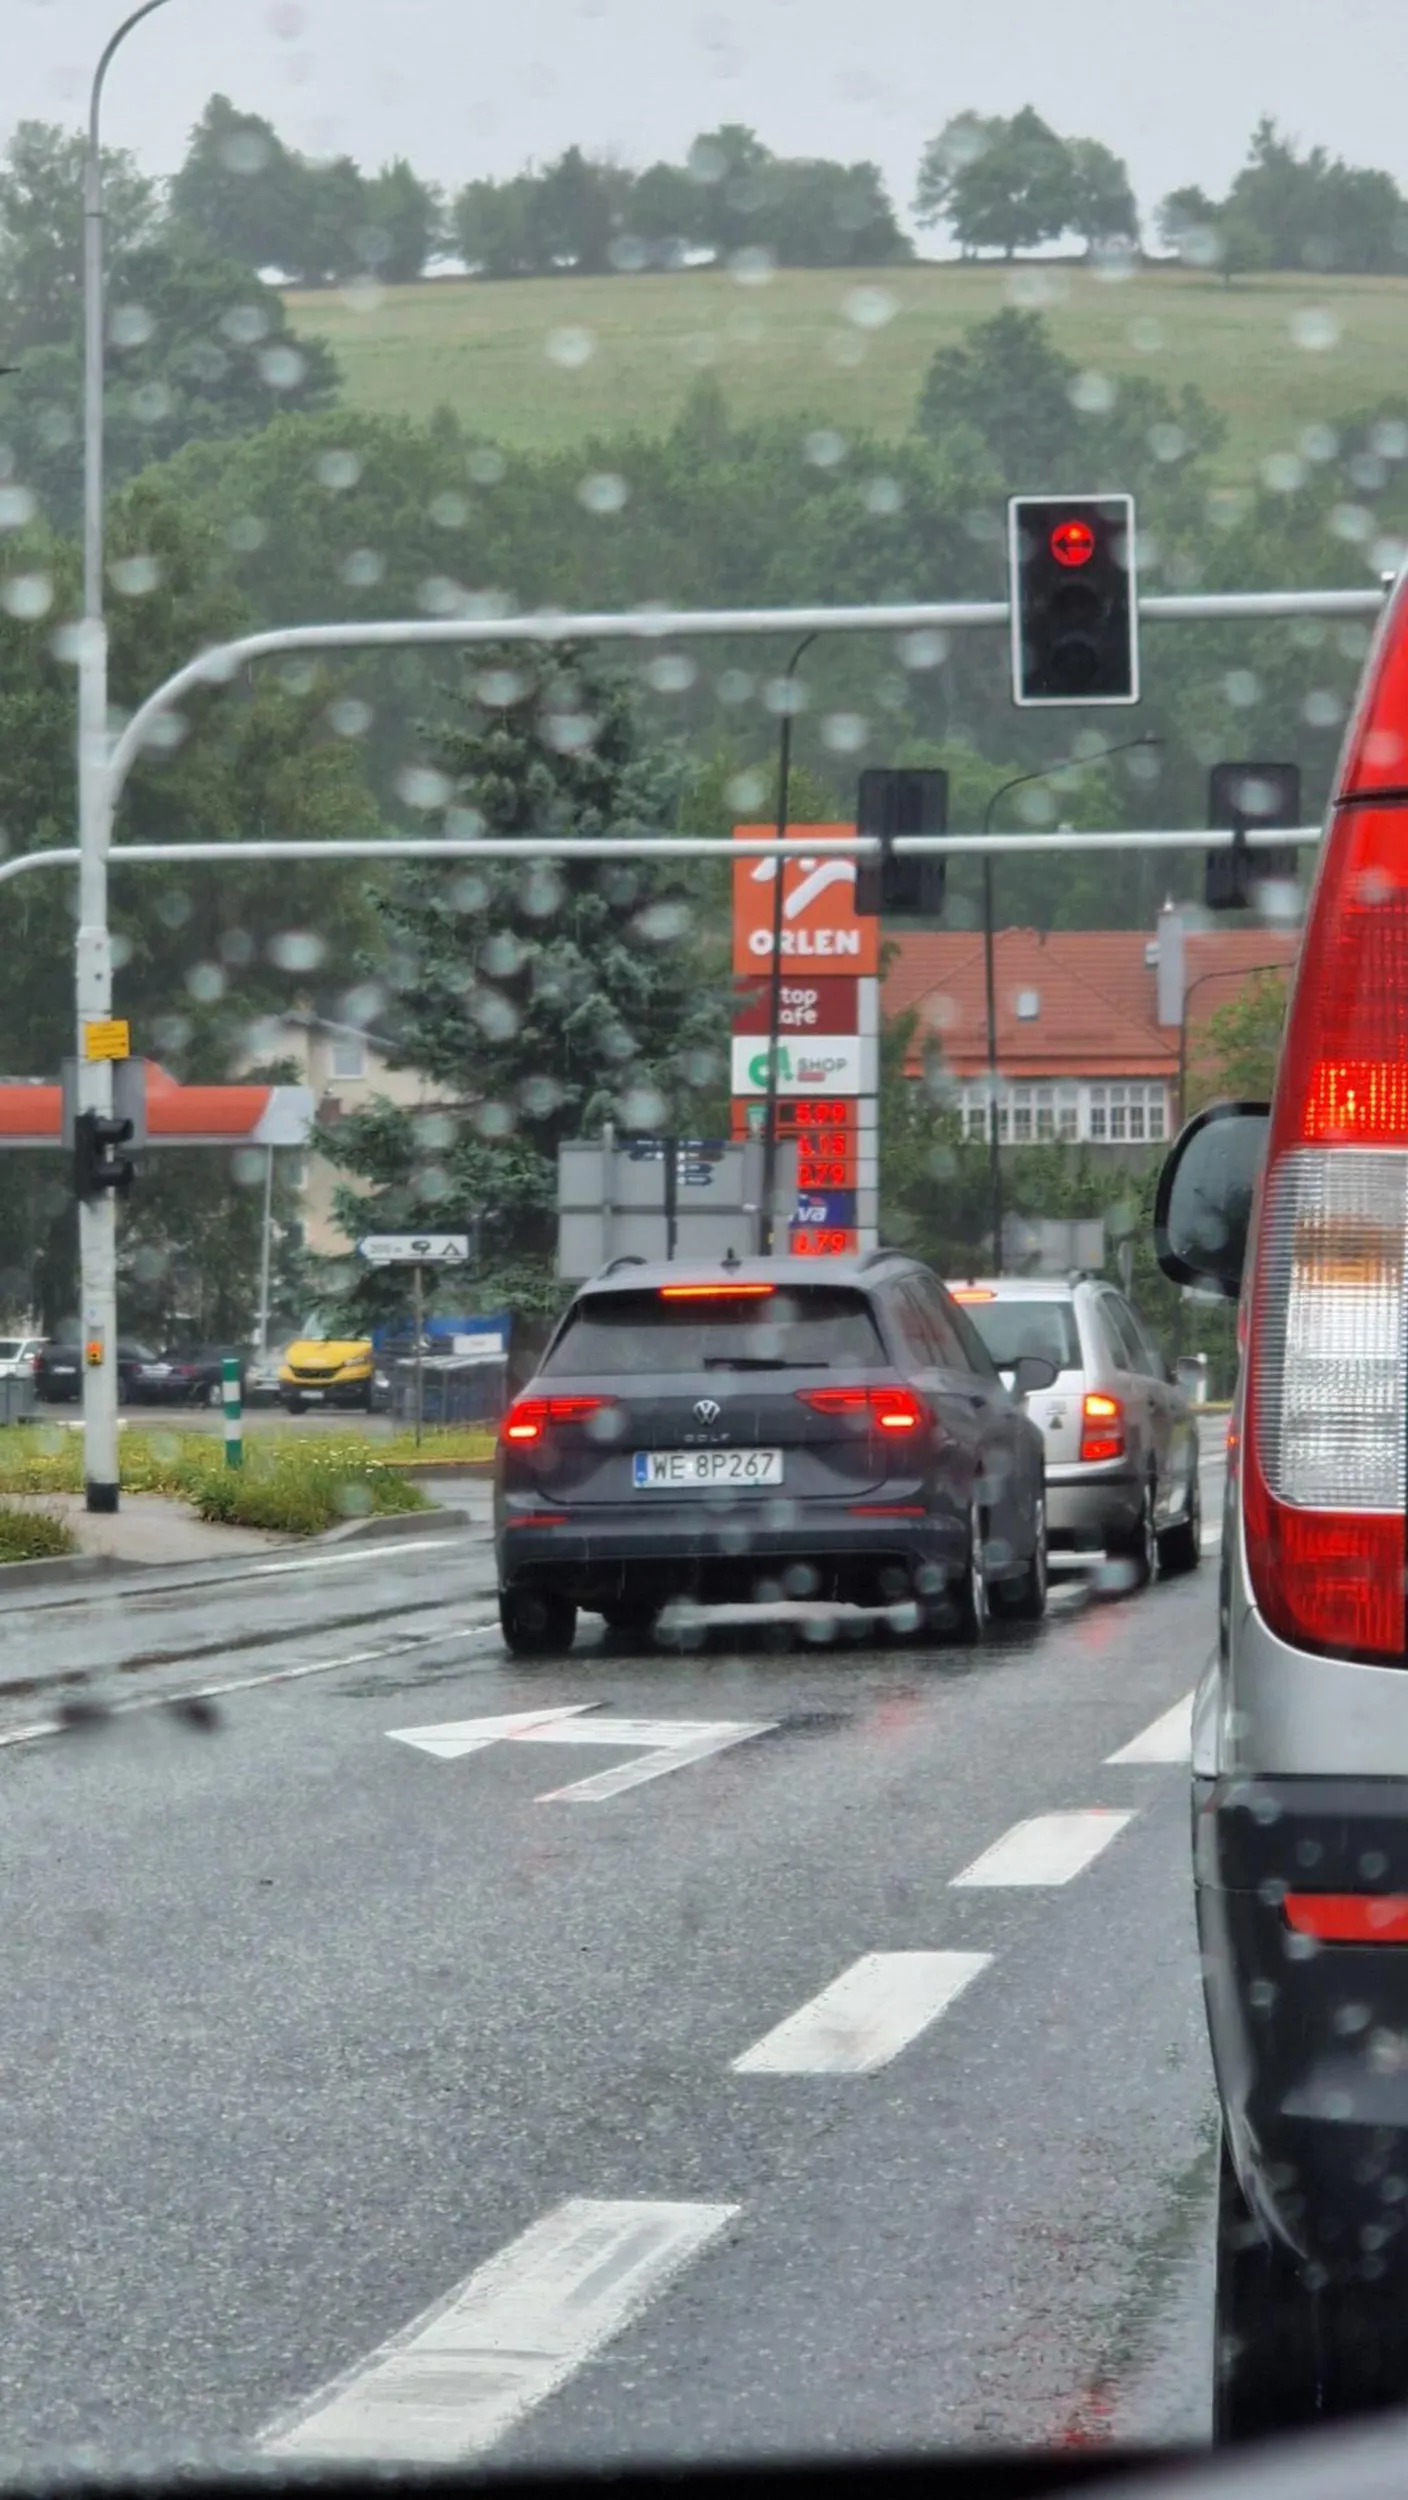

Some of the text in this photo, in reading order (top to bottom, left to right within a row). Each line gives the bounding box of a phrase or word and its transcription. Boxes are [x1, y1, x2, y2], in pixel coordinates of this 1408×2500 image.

[749, 929, 860, 955] ORLEN
[779, 987, 817, 1007] top
[778, 1008, 818, 1026] afe
[798, 1058, 847, 1072] SHOP
[653, 1452, 774, 1480] WE 8P267
